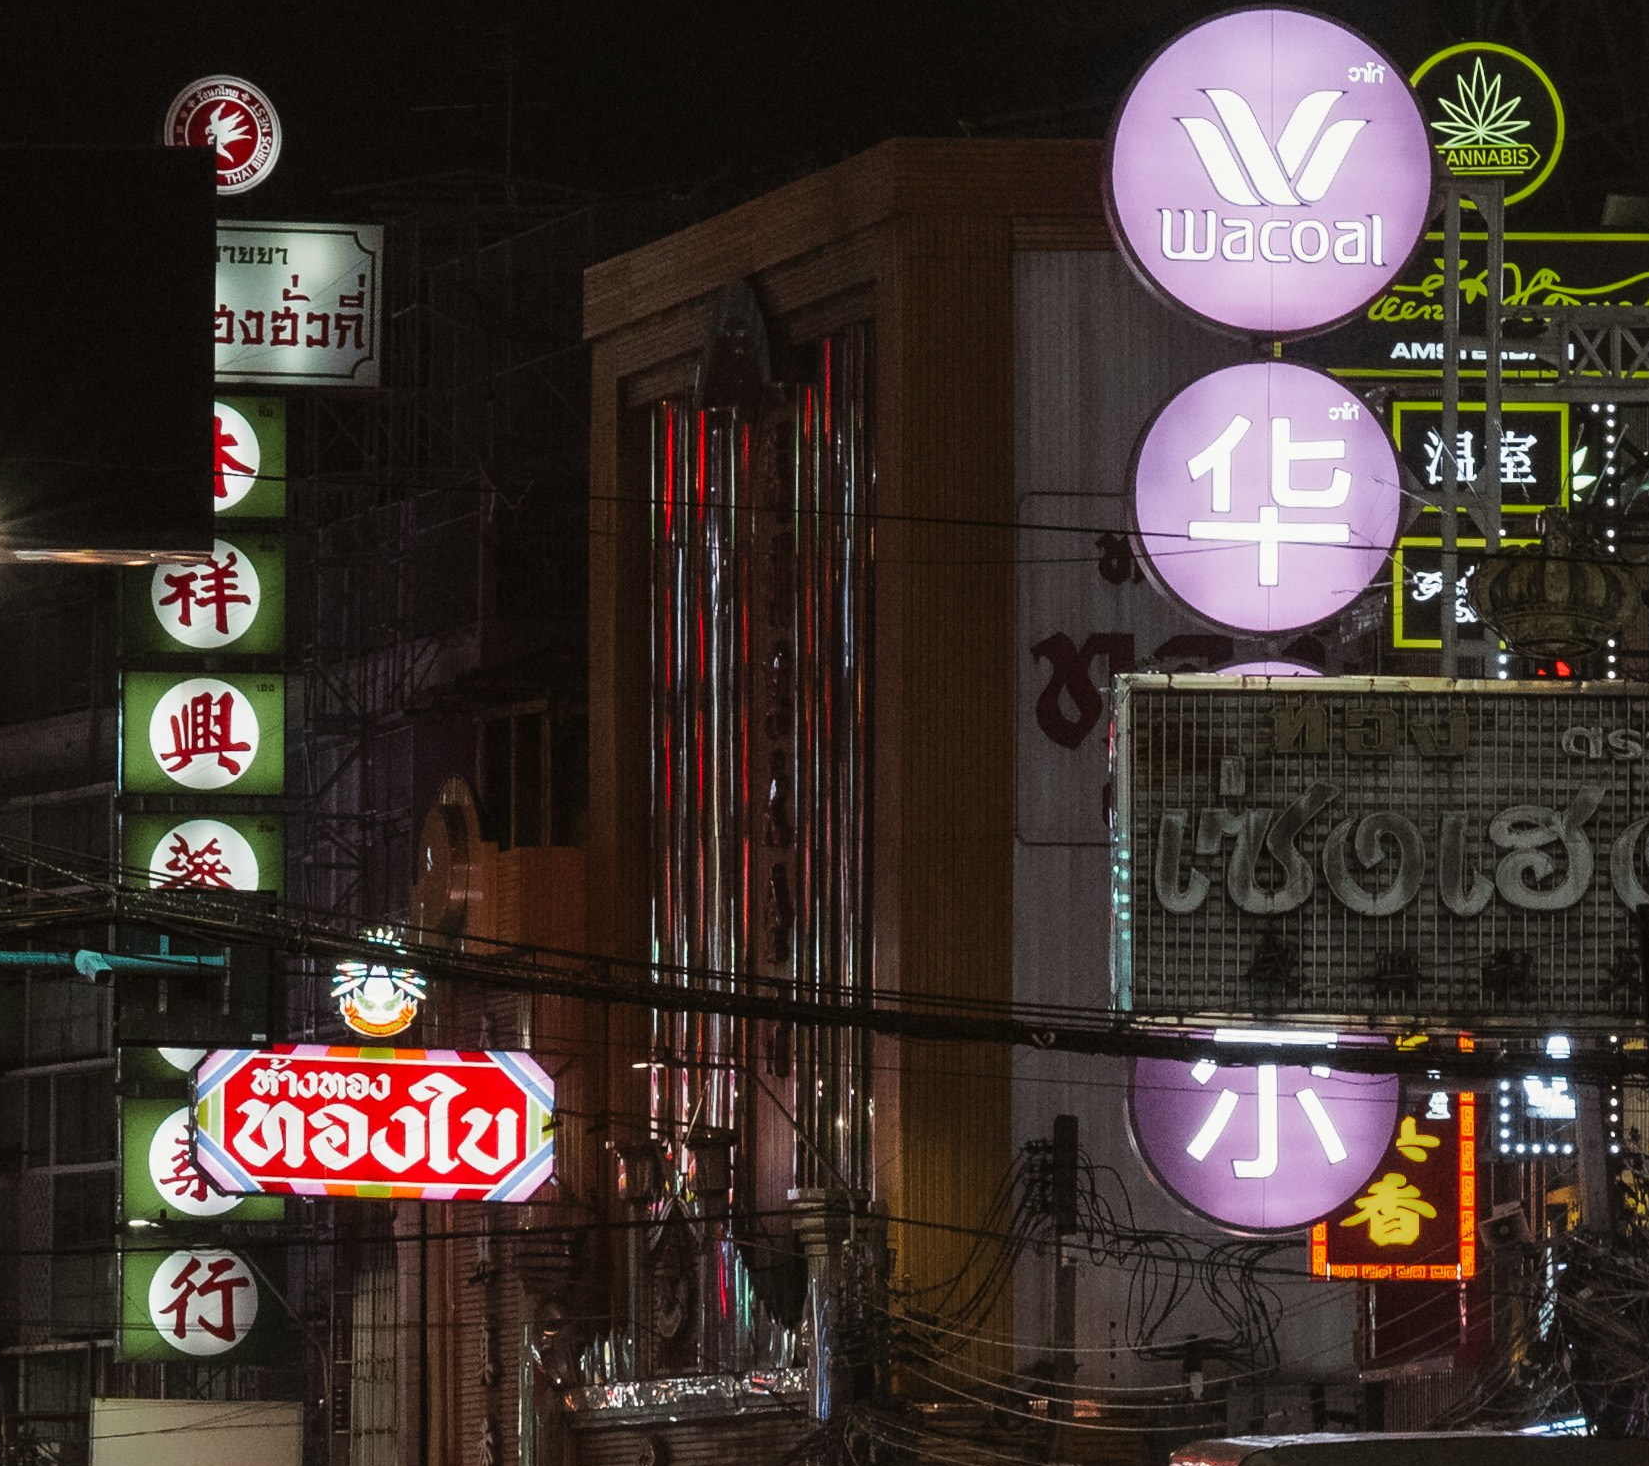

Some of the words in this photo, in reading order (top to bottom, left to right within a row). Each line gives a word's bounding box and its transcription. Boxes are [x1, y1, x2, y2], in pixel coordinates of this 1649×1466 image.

[250, 102, 273, 133] NEST
[251, 134, 273, 171] BIRDS
[224, 167, 254, 185] THAI
[1159, 207, 1387, 267] Wacoal
[251, 1058, 392, 1103] ห้างทอง
[232, 1073, 521, 1178] ทองใบ
